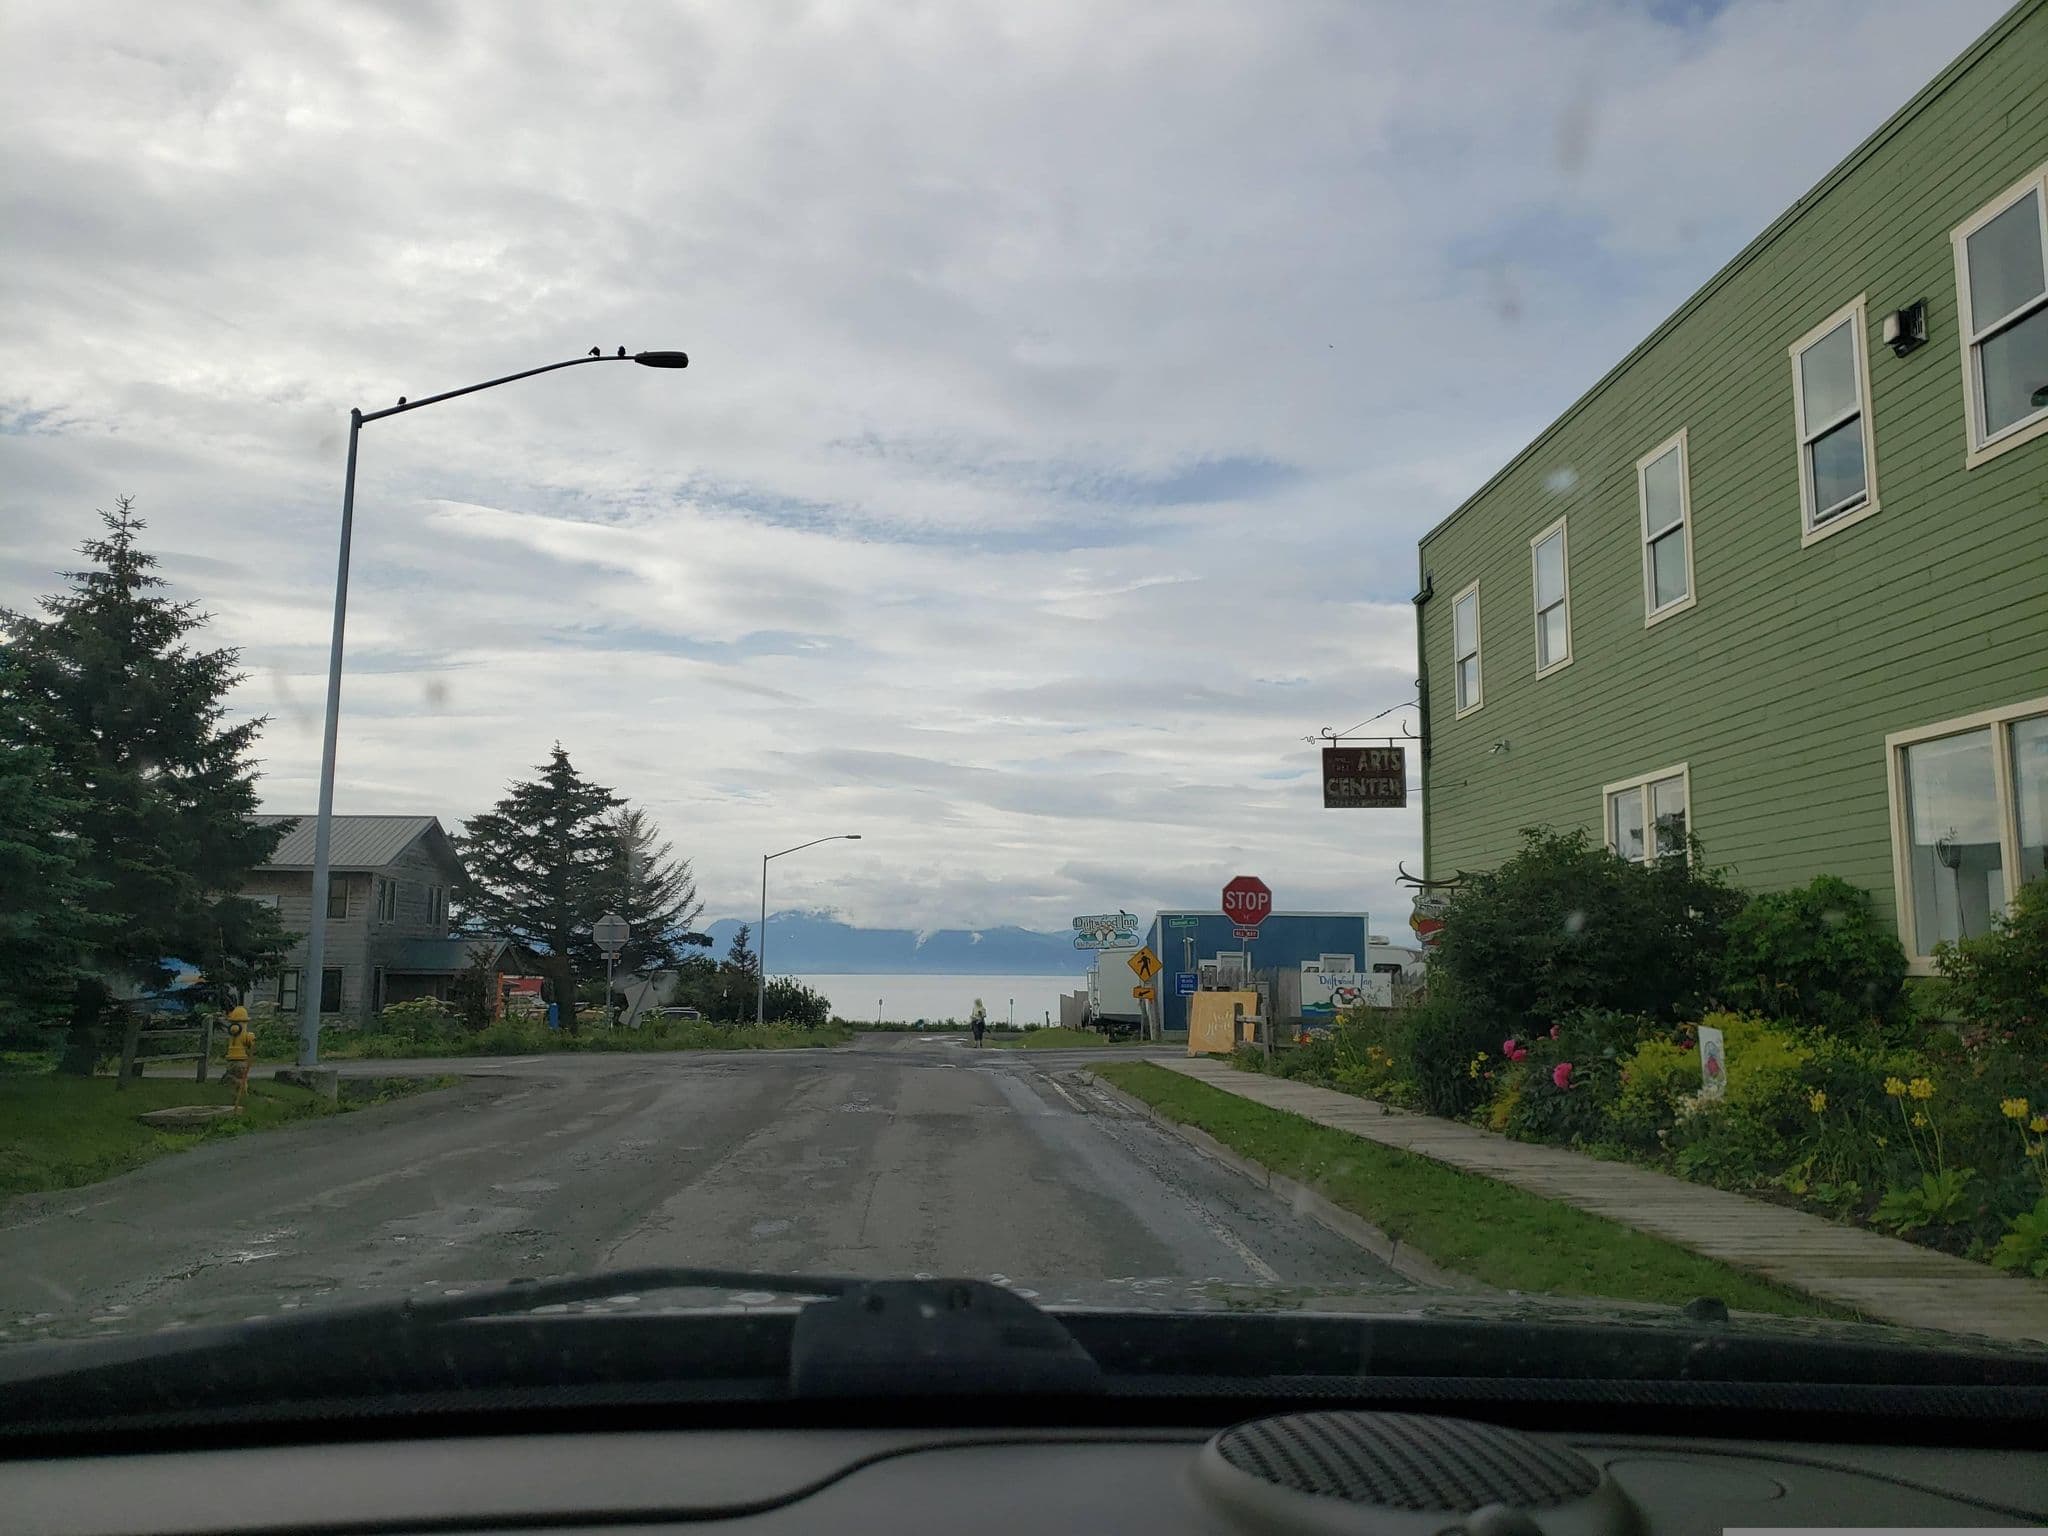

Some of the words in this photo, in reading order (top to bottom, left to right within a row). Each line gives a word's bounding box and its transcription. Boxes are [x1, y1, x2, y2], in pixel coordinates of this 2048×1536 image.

[1357, 751, 1399, 771] ARTS
[1327, 776, 1401, 796] CENTER
[1225, 891, 1270, 910] STOP
[1074, 916, 1119, 933] Driftwood
[1120, 914, 1137, 930] Inn
[1317, 973, 1355, 990] Driftwood
[1359, 973, 1374, 990] Inn
